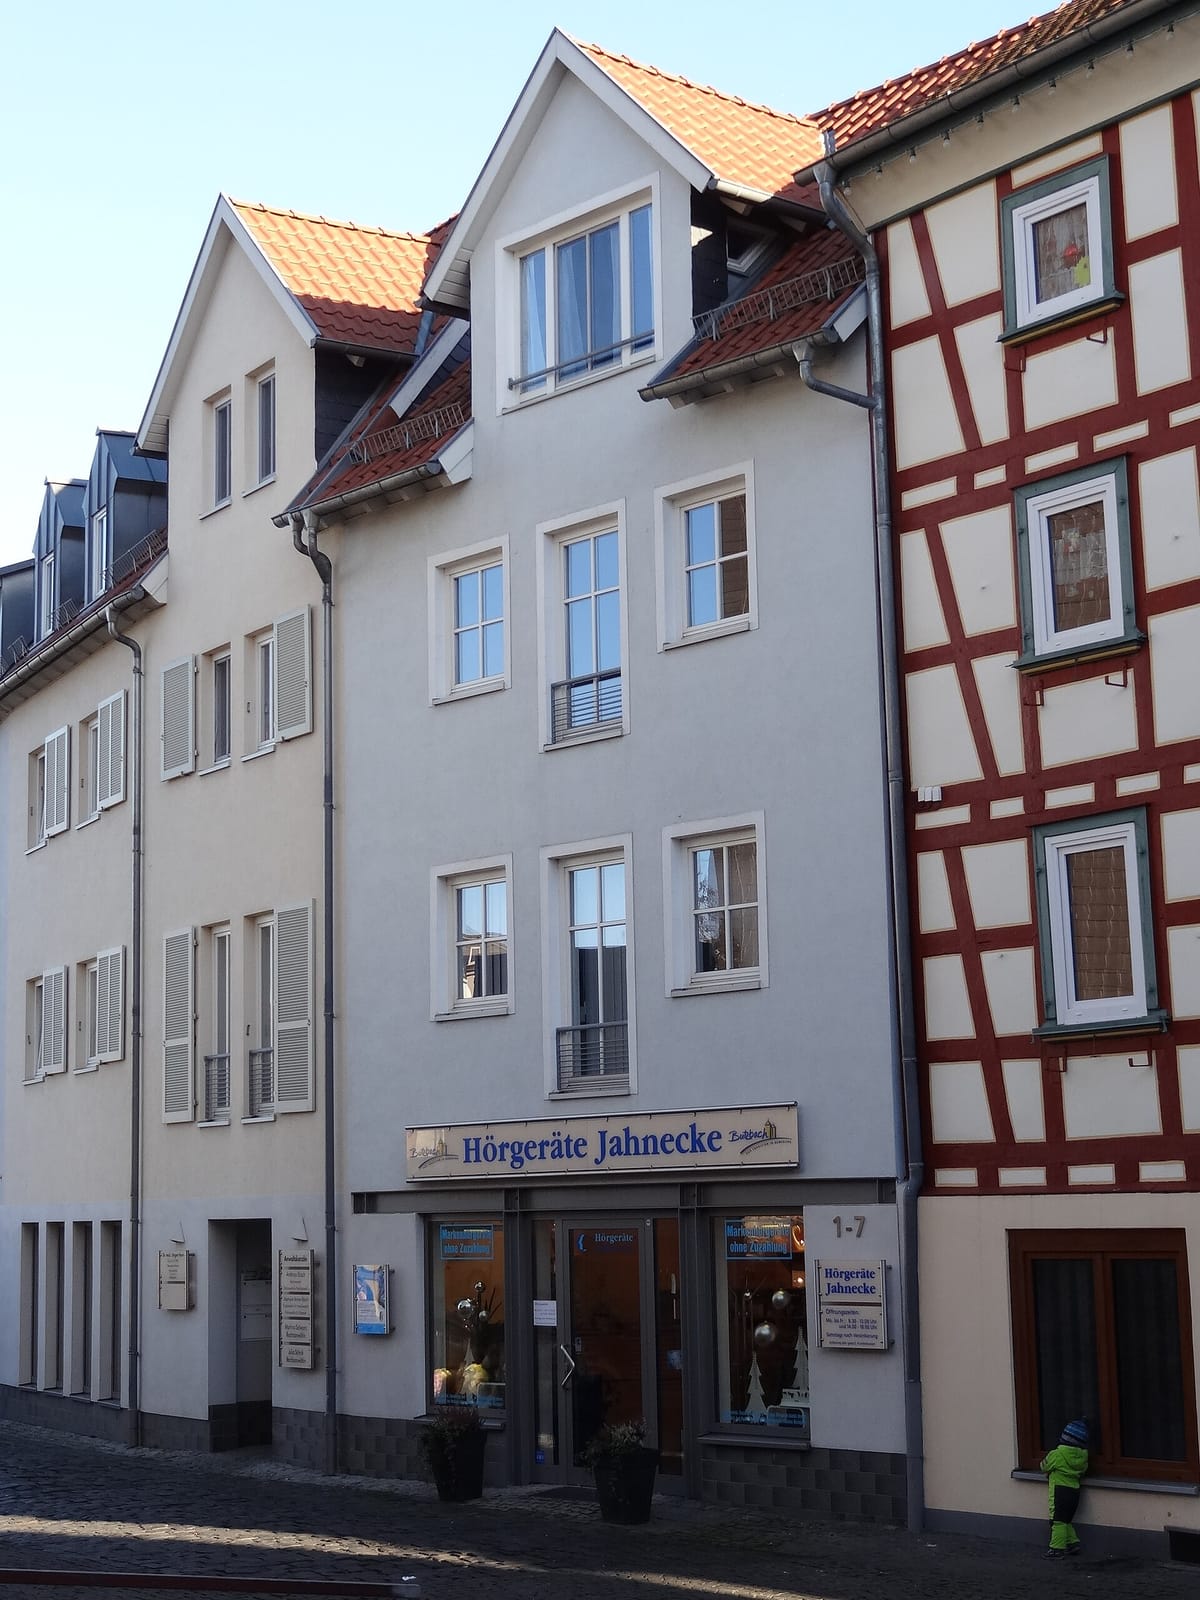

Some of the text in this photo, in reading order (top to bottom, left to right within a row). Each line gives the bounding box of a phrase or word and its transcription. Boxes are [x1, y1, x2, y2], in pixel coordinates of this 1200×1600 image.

[462, 1121, 723, 1170] Hörgeräte Jahnecke
[832, 1215, 866, 1238] 1-7
[595, 1232, 633, 1244] Hörgeräte
[729, 1241, 787, 1255] ohne Zuzahlung
[825, 1267, 876, 1282] Hörgeräte
[825, 1282, 876, 1296] Jahnecke
